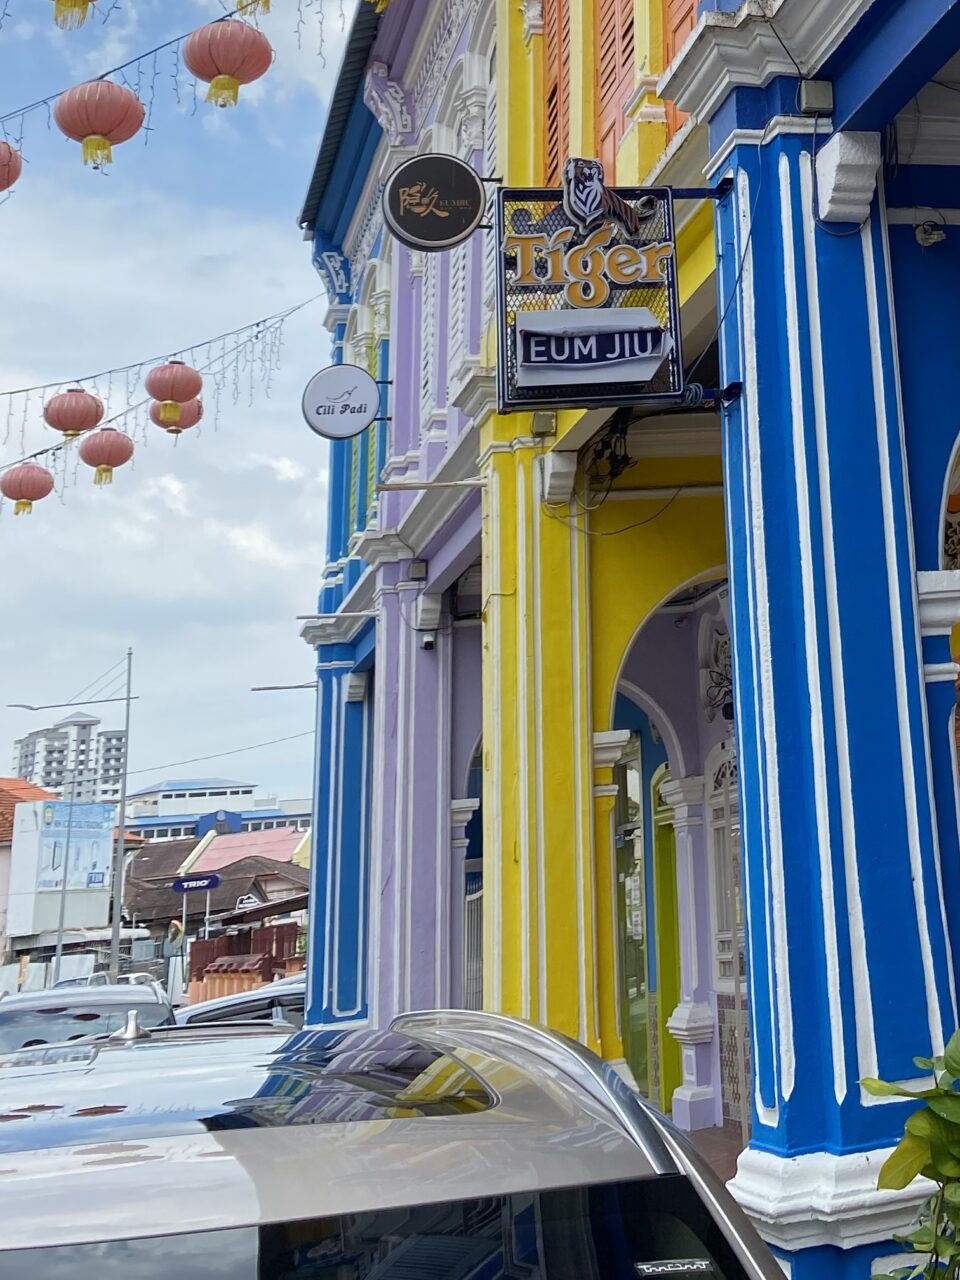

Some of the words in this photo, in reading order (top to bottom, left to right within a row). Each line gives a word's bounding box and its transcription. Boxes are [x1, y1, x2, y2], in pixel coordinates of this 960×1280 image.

[500, 226, 674, 309] Tiger
[530, 334, 597, 362] EUM
[606, 331, 652, 358] JIU
[315, 404, 336, 416] Cili
[339, 403, 368, 415] Padi
[182, 879, 211, 889] TRIO
